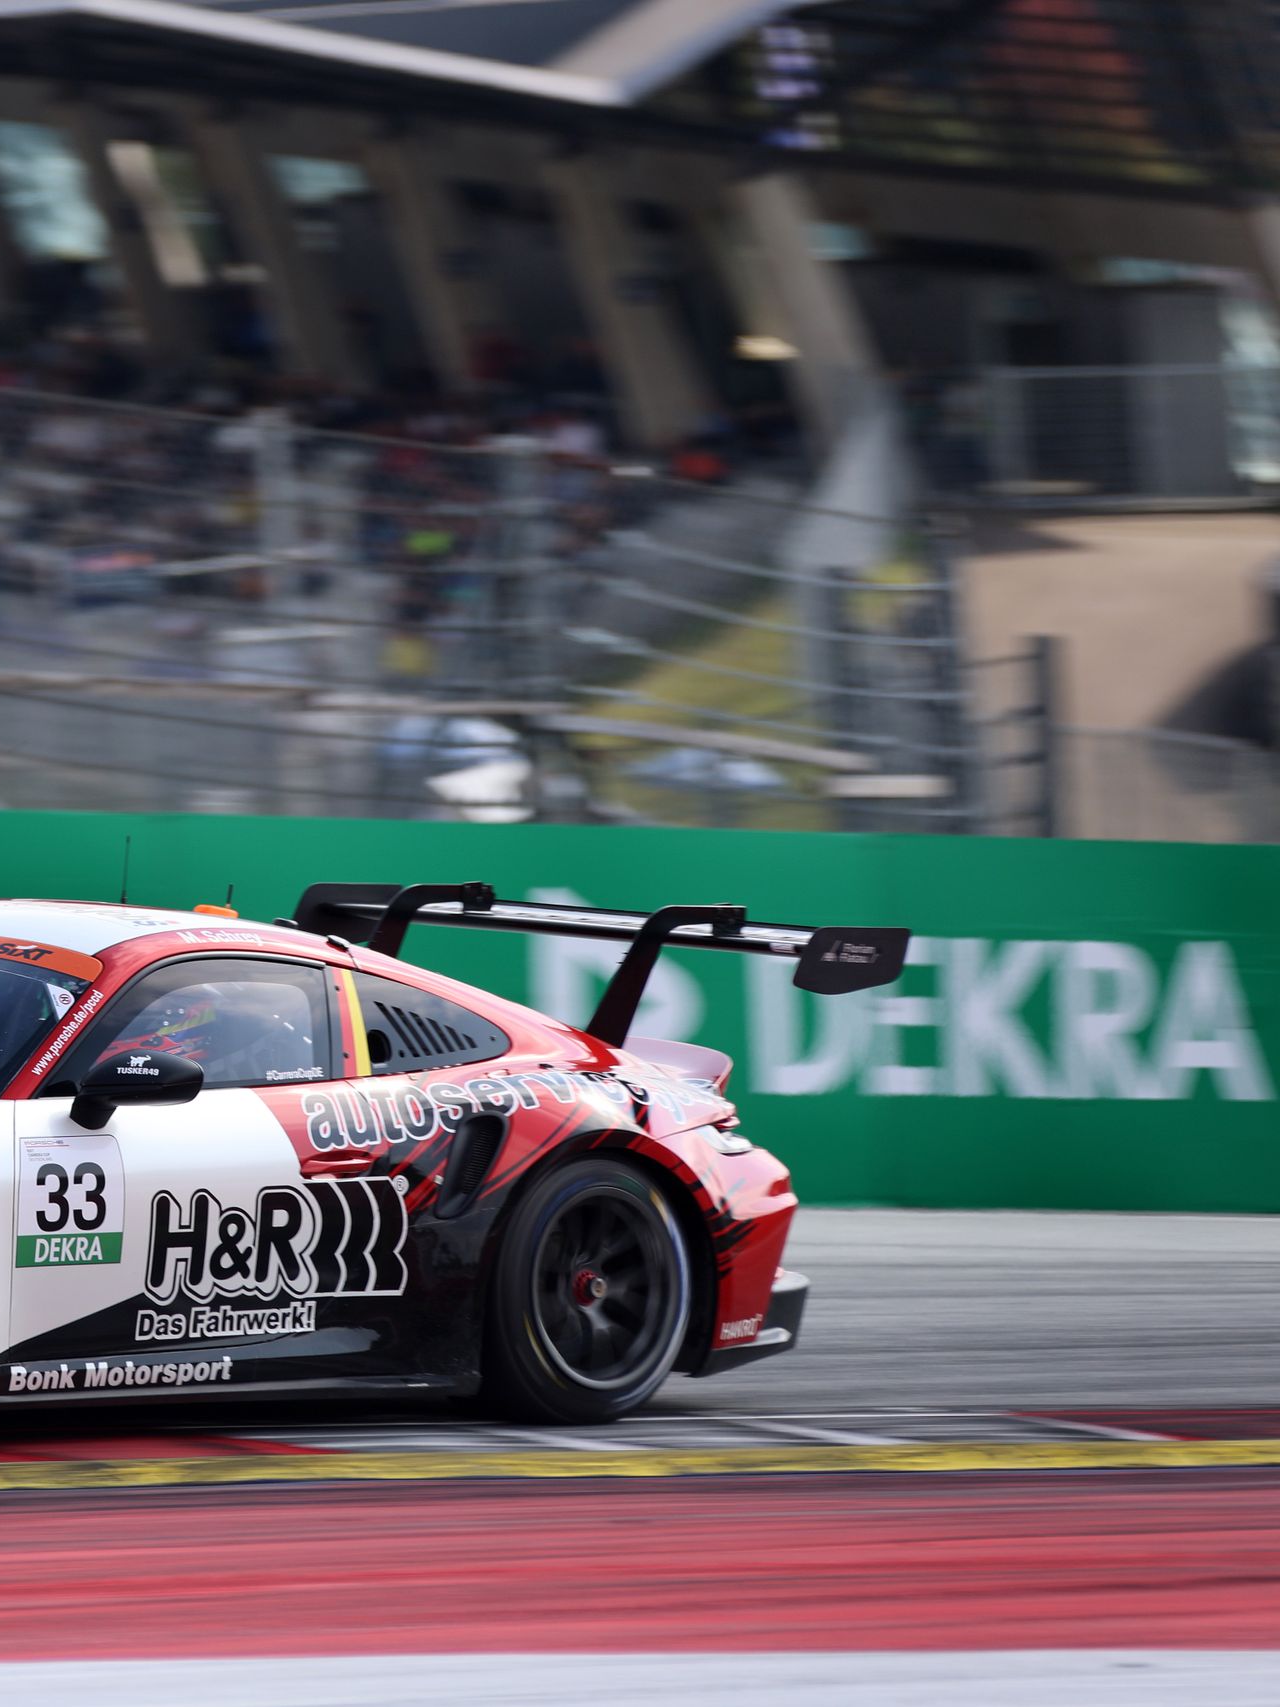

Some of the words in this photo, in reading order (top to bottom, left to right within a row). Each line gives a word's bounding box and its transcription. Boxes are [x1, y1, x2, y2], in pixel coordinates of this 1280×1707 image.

[31, 989, 105, 1076] www.porsche.de/pccd
[744, 934, 1274, 1100] DEKRA
[116, 1066, 160, 1076] TUSKER49
[35, 1162, 107, 1233] 33
[33, 1236, 104, 1263] DEKRA
[145, 1183, 318, 1305] H&R
[135, 1309, 185, 1341] Das
[188, 1301, 317, 1336] Fahrwerk!
[8, 1363, 77, 1392] Bonk
[83, 1355, 234, 1388] Motorsport
